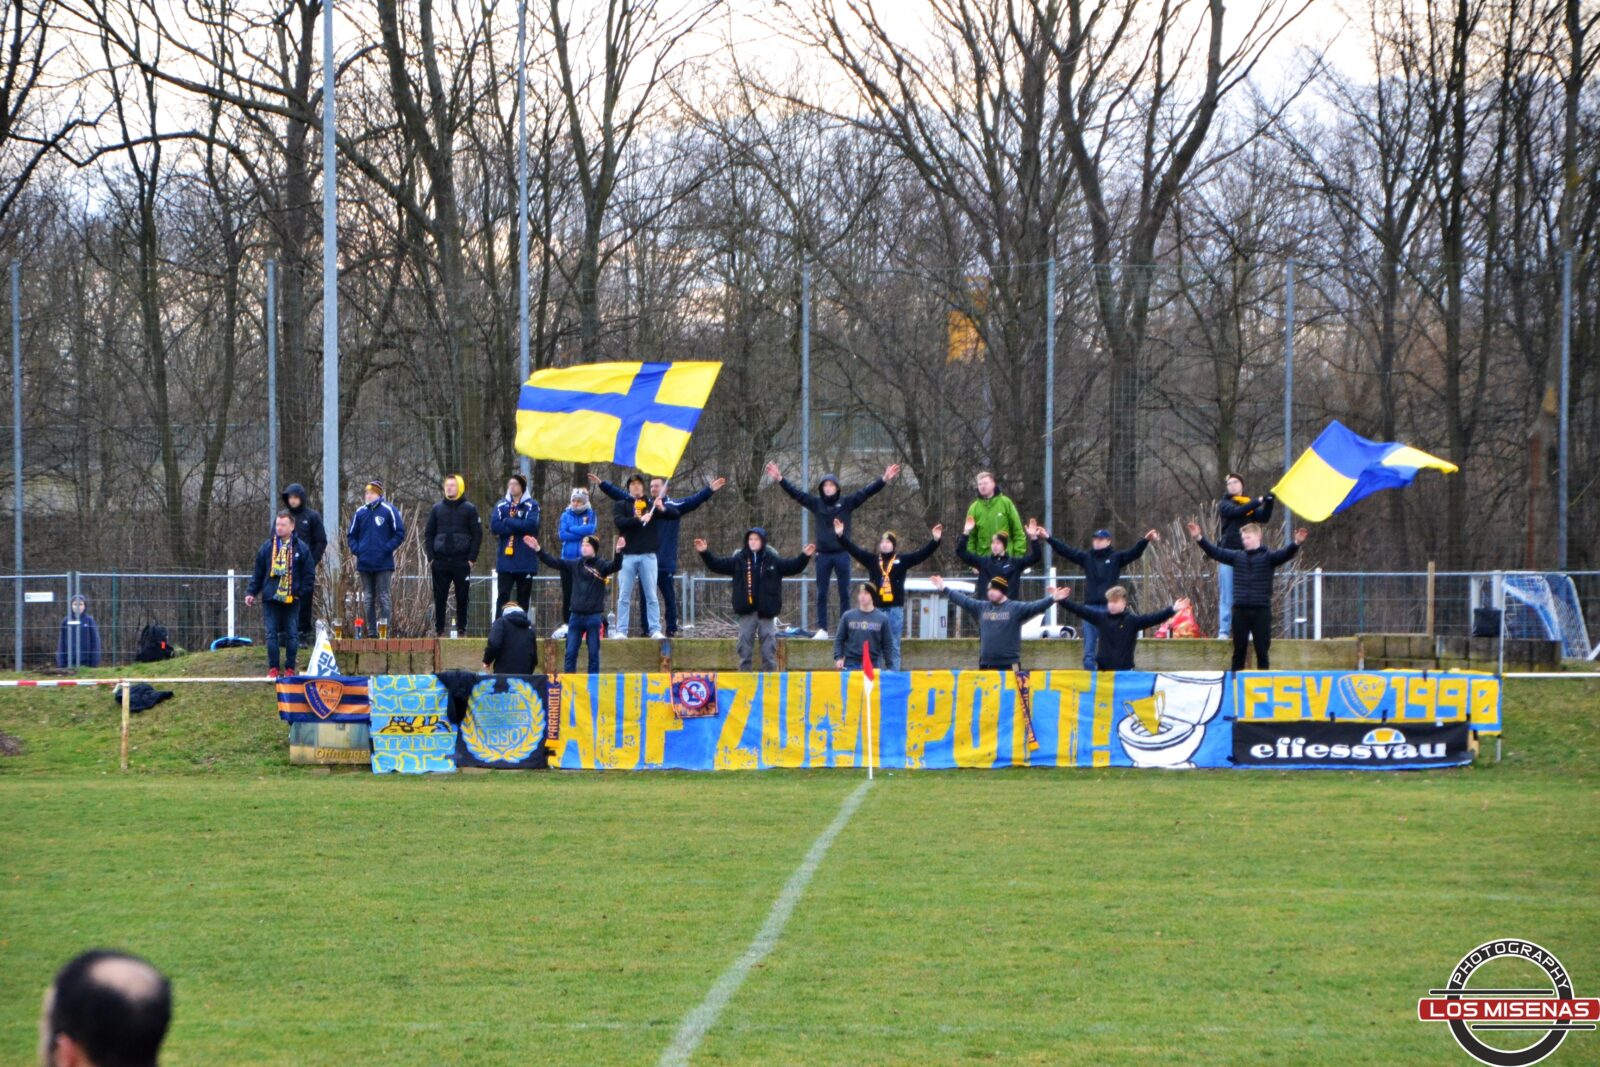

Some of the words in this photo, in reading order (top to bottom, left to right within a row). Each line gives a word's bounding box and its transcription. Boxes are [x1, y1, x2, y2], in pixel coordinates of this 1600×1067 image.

[548, 688, 561, 739] PARANOIA
[549, 673, 684, 770] AUF
[713, 670, 881, 770] ZUM
[906, 669, 1115, 770] POTT!
[1243, 676, 1333, 720] FSV
[1390, 677, 1500, 725] 1990
[315, 747, 370, 761] Öffnungs
[1249, 737, 1447, 760] effessvau
